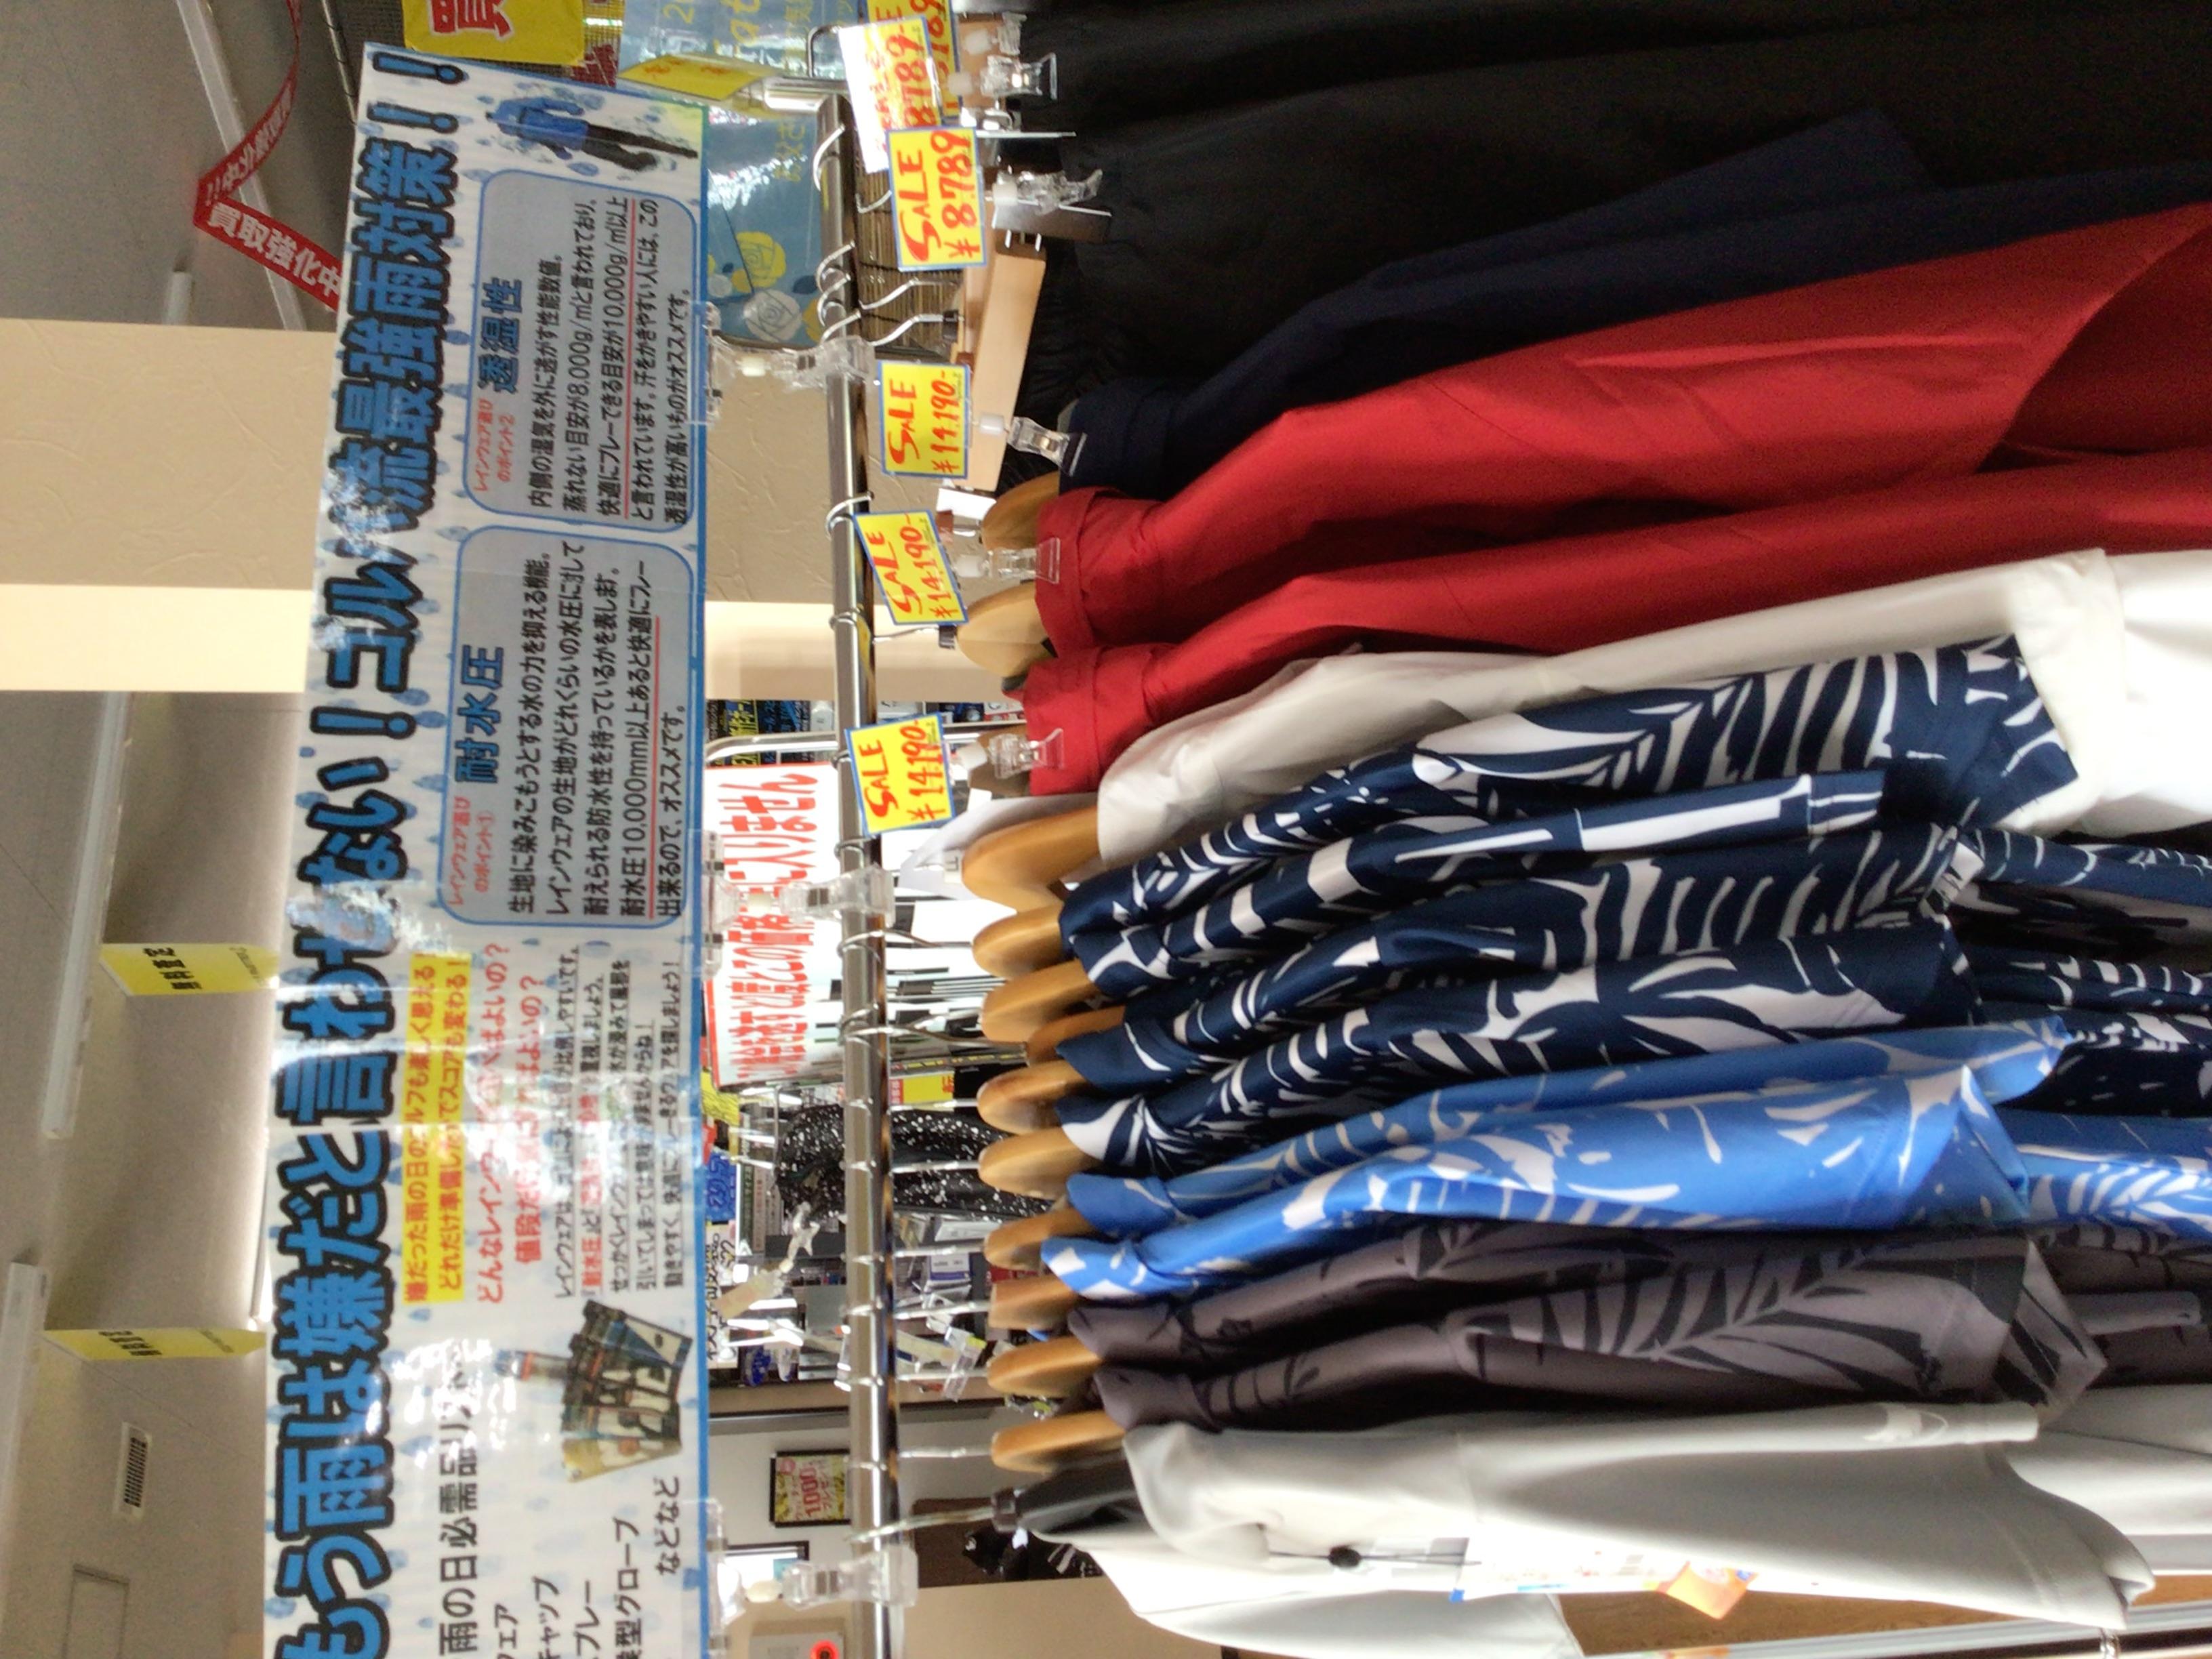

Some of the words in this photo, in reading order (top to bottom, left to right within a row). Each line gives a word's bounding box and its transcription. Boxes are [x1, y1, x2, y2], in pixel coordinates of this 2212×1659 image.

[897, 149, 941, 262] SALE
[478, 277, 522, 393] 透湿性
[474, 398, 493, 492] レインウェア選び
[888, 378, 920, 464] SALE
[865, 531, 922, 615] SALE
[453, 644, 504, 783] 耐水圧
[655, 706, 684, 917] 出来るので、オススメです。
[858, 739, 898, 818] SALE
[448, 796, 470, 906] レインウェア選び
[438, 1361, 478, 1656] 雨の日必需品リス
[653, 1476, 680, 1575] などなど
[574, 1580, 600, 1659] プレー
